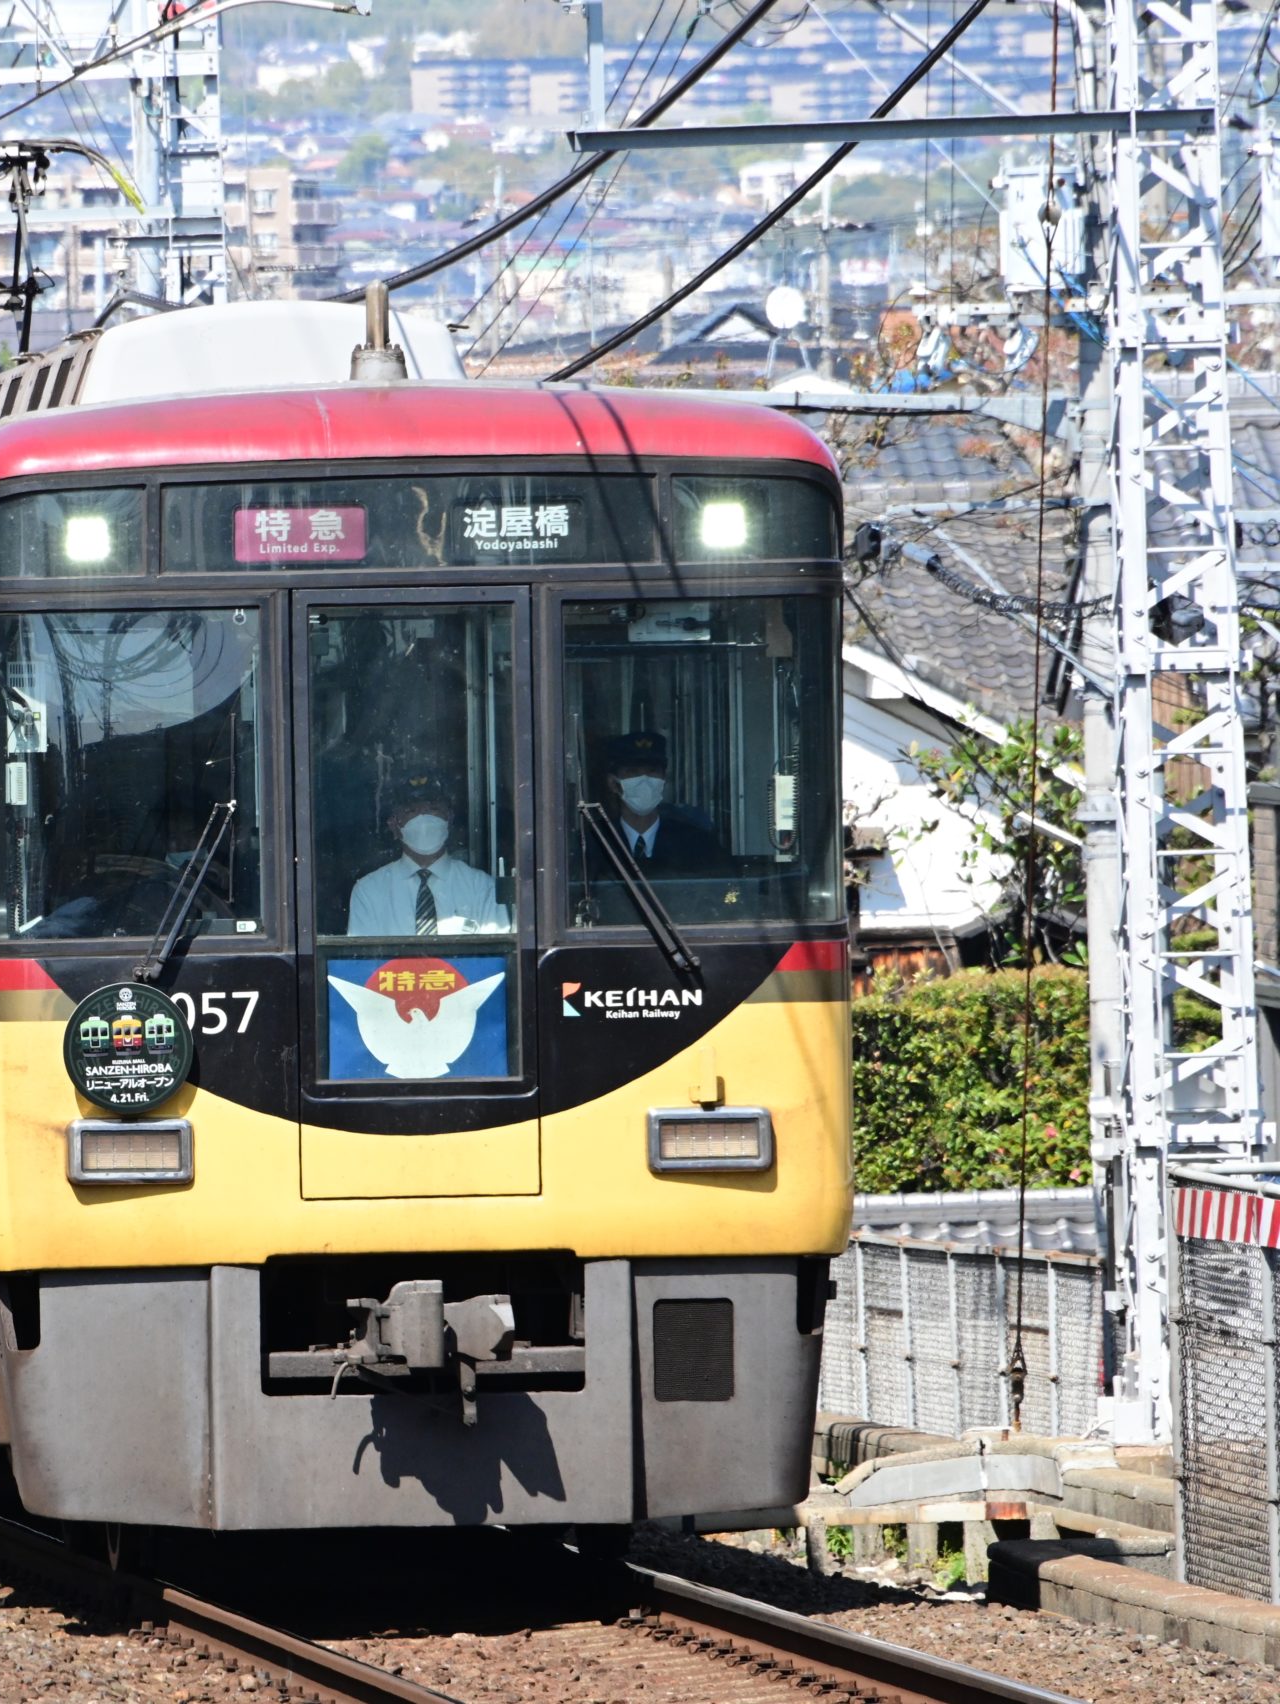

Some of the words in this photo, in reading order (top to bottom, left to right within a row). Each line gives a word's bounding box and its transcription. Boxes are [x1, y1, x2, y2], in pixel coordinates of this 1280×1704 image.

[255, 509, 345, 541] 特急
[463, 505, 569, 538] 淀屋橋
[260, 543, 308, 554] Limited
[313, 543, 340, 555] Exp.
[475, 538, 559, 552] Yodoyabashi
[379, 970, 455, 992] 特急
[584, 987, 703, 1007] KEIHAN
[606, 1010, 639, 1019] Keihan
[642, 1009, 680, 1020] Railway
[85, 1063, 173, 1076] SANZEN-HIROBA
[86, 1077, 174, 1090] リニューアルオープン
